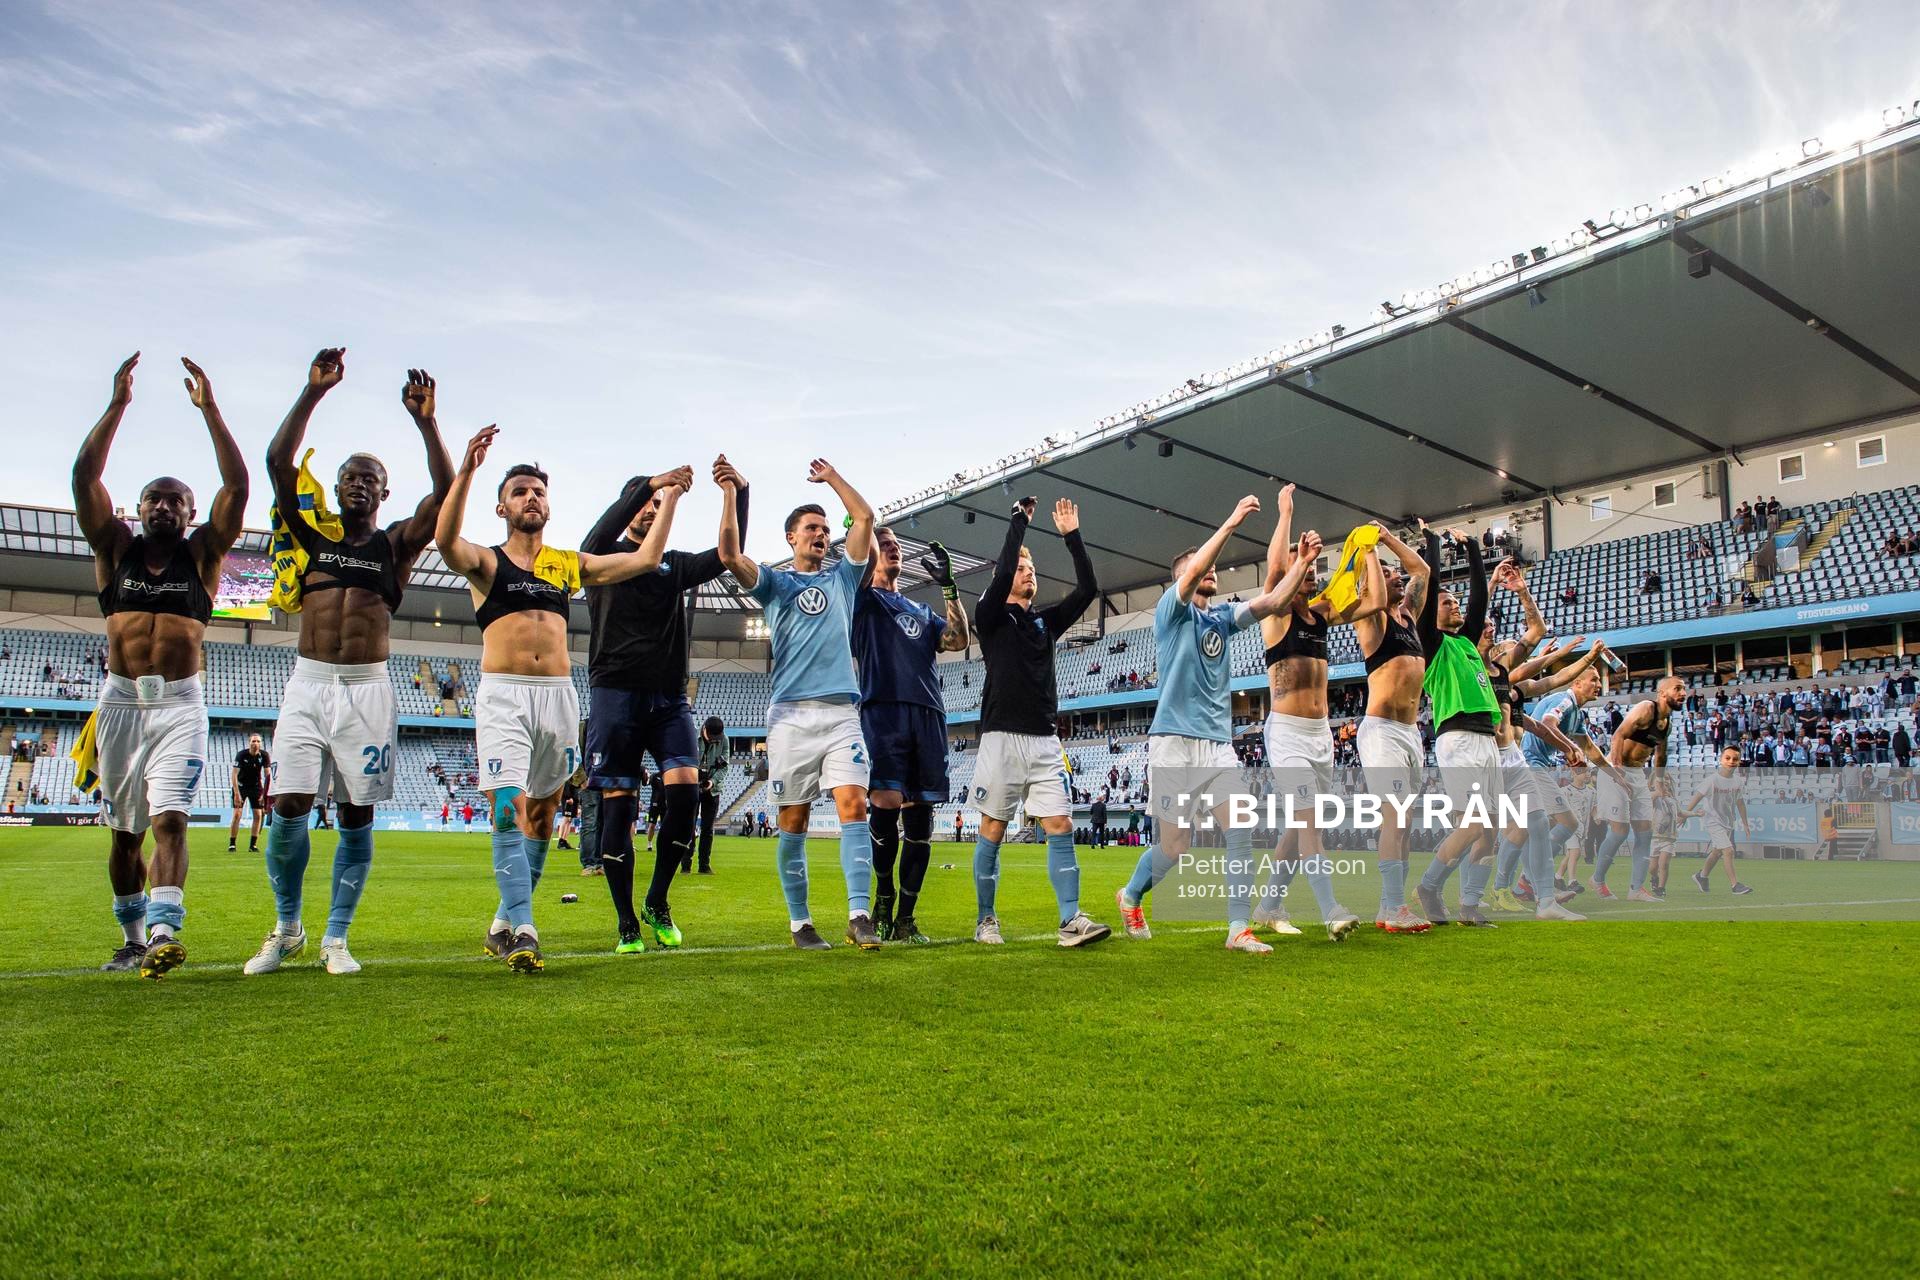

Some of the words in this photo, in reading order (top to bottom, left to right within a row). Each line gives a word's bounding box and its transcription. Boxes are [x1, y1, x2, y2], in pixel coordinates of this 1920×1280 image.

[186, 758, 204, 790] 7
[362, 744, 391, 776] 20
[1773, 816, 1808, 832] 1965
